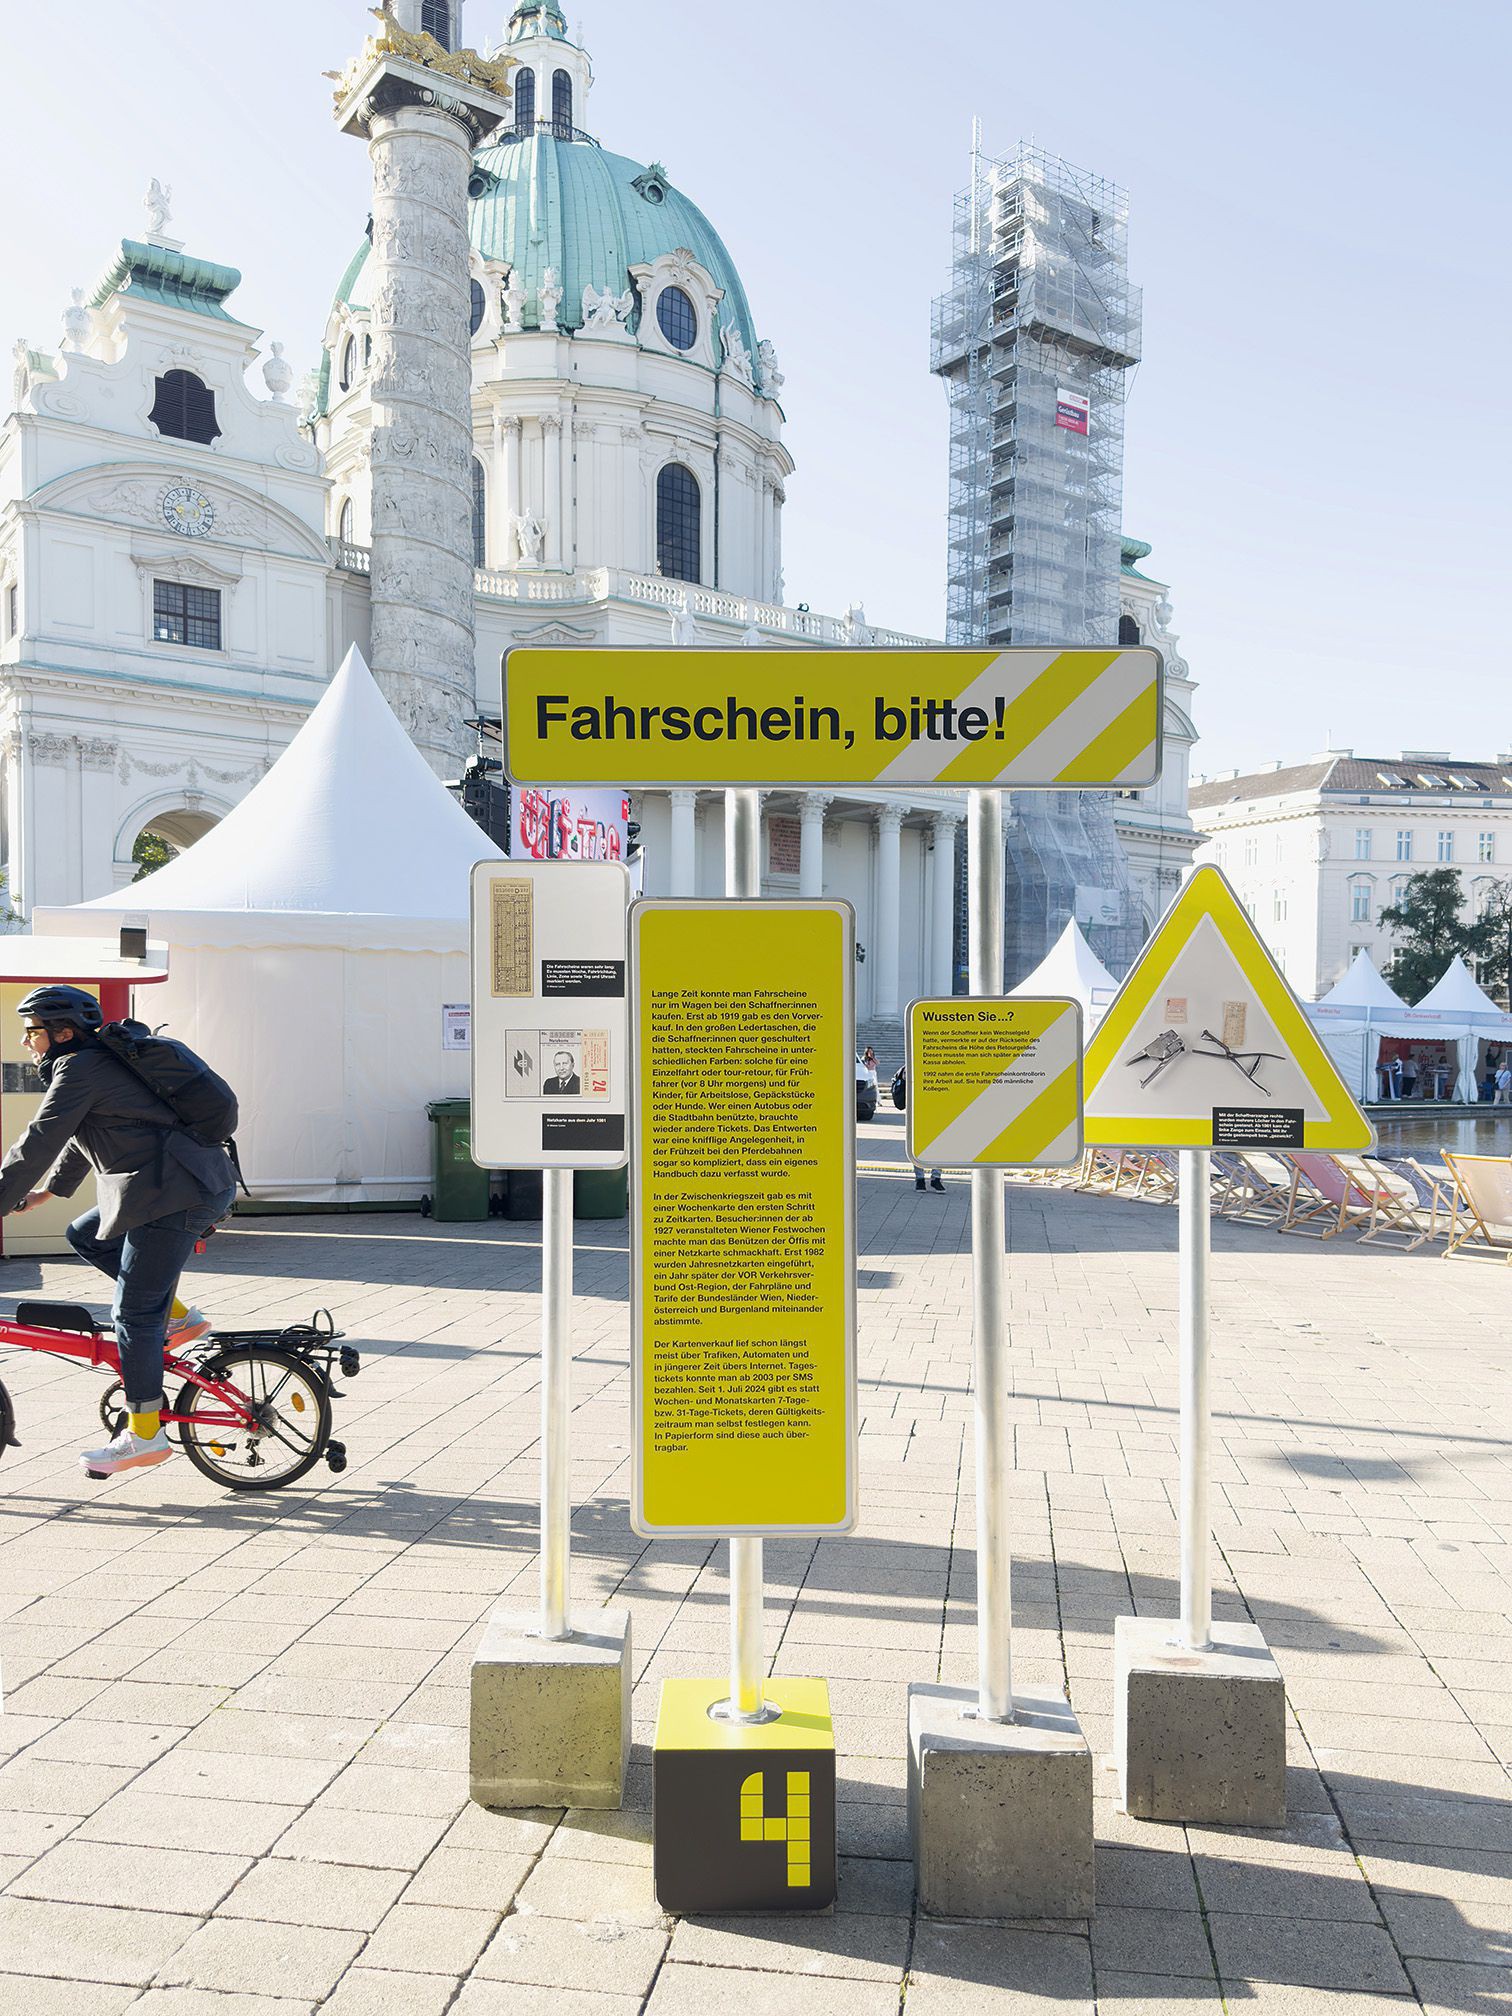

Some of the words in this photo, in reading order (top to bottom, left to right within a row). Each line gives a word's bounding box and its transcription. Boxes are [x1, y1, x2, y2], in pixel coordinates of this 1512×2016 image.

[536, 696, 855, 750] Fahrschein,
[875, 696, 1007, 741] bitte!
[652, 989, 679, 999] Lange
[682, 1001, 712, 1010] Wagen
[742, 1012, 758, 1021] gab
[923, 1012, 974, 1021] Wussten
[978, 1012, 1014, 1021] Sie...?
[681, 1079, 697, 1088] (vor
[653, 1091, 683, 1099] Kinder,
[700, 1090, 751, 1099] Arbeitslose,
[754, 1090, 815, 1100] Gepäckstücke
[681, 1192, 764, 1202] Zwischenkriegszeit
[767, 1192, 783, 1201] gab
[780, 1339, 807, 1348] längst
[768, 1385, 785, 1394] gibt
[778, 1396, 810, 1406] 7-Tage-
[677, 1408, 746, 1418] 31-Tage-Tickets,
[776, 1408, 825, 1417] Gültigkeits-
[740, 1772, 810, 1887] 4
